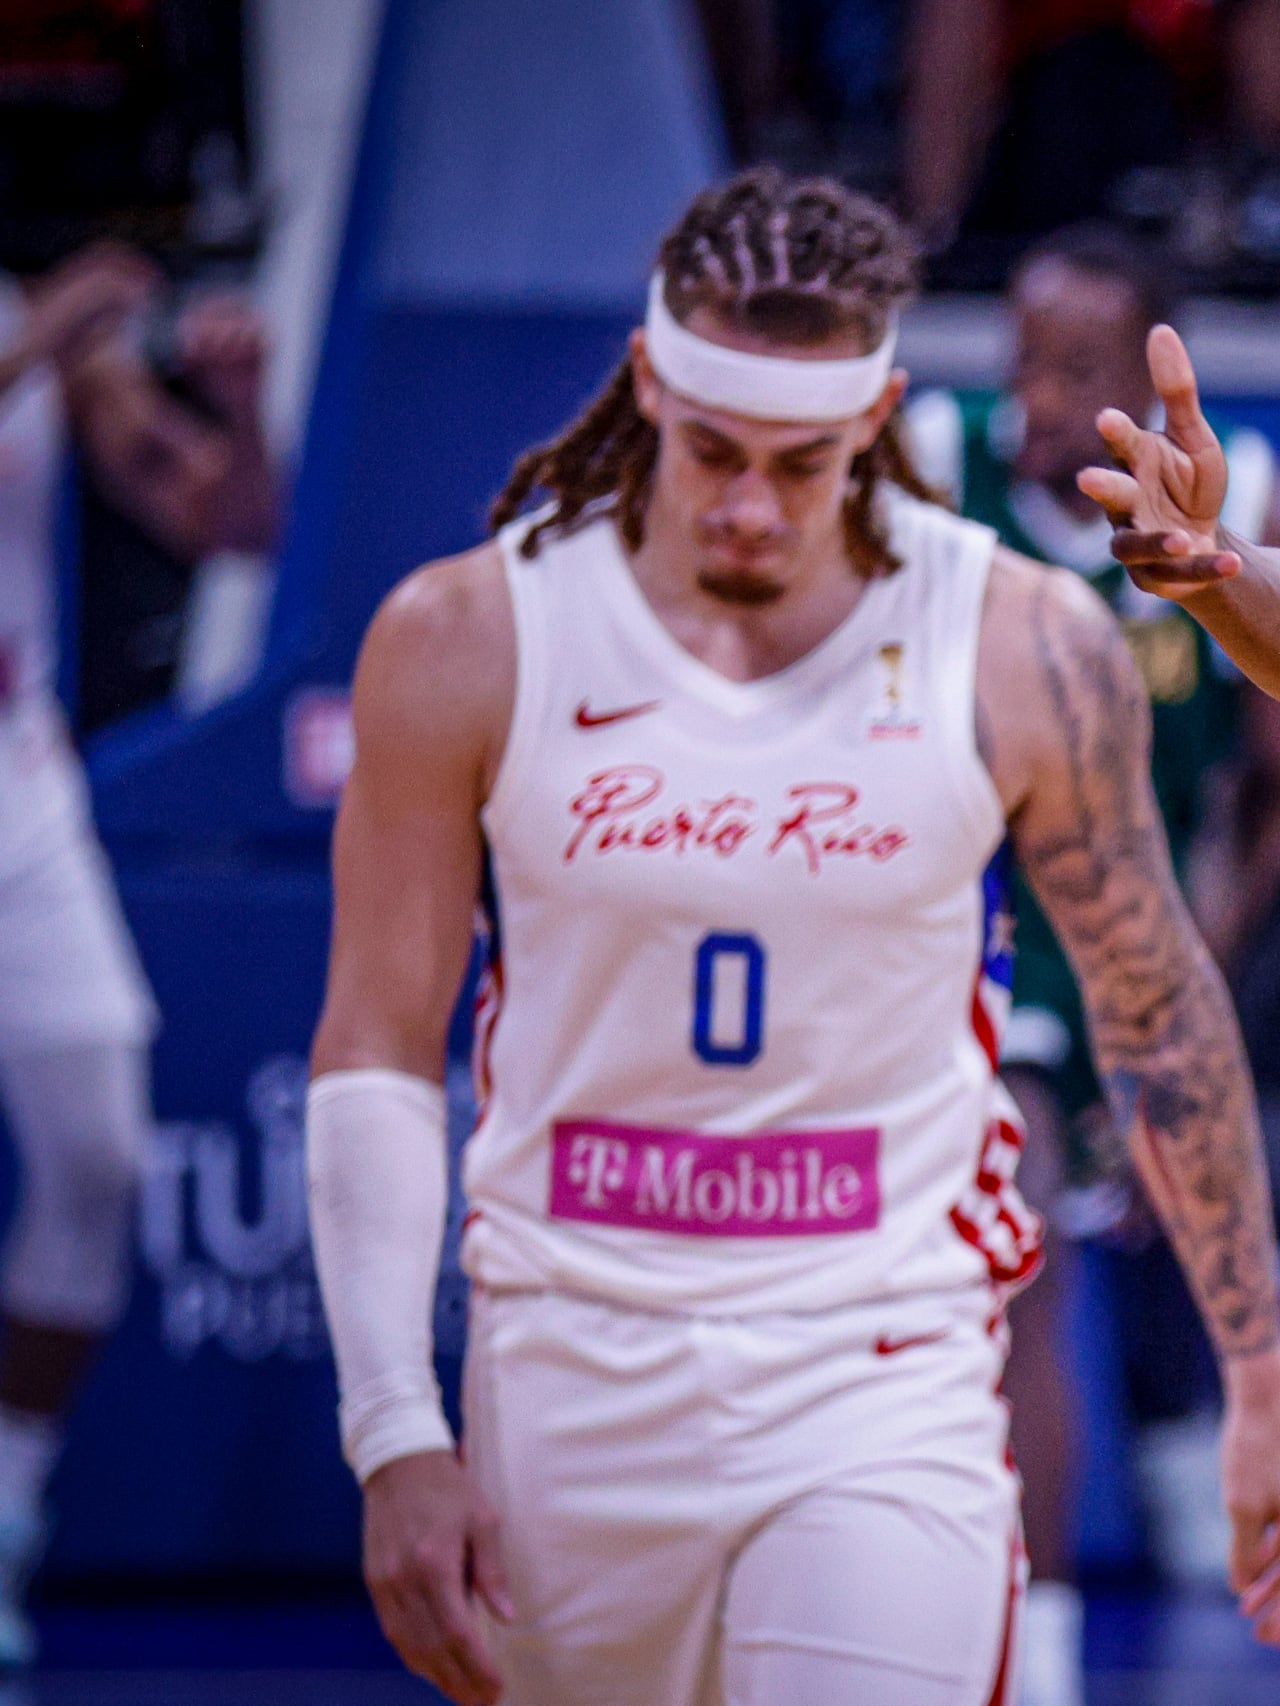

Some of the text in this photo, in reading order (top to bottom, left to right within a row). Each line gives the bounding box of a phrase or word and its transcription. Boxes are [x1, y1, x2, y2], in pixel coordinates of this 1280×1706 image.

[563, 765, 909, 876] Puerto Rico
[692, 930, 768, 1068] 0
